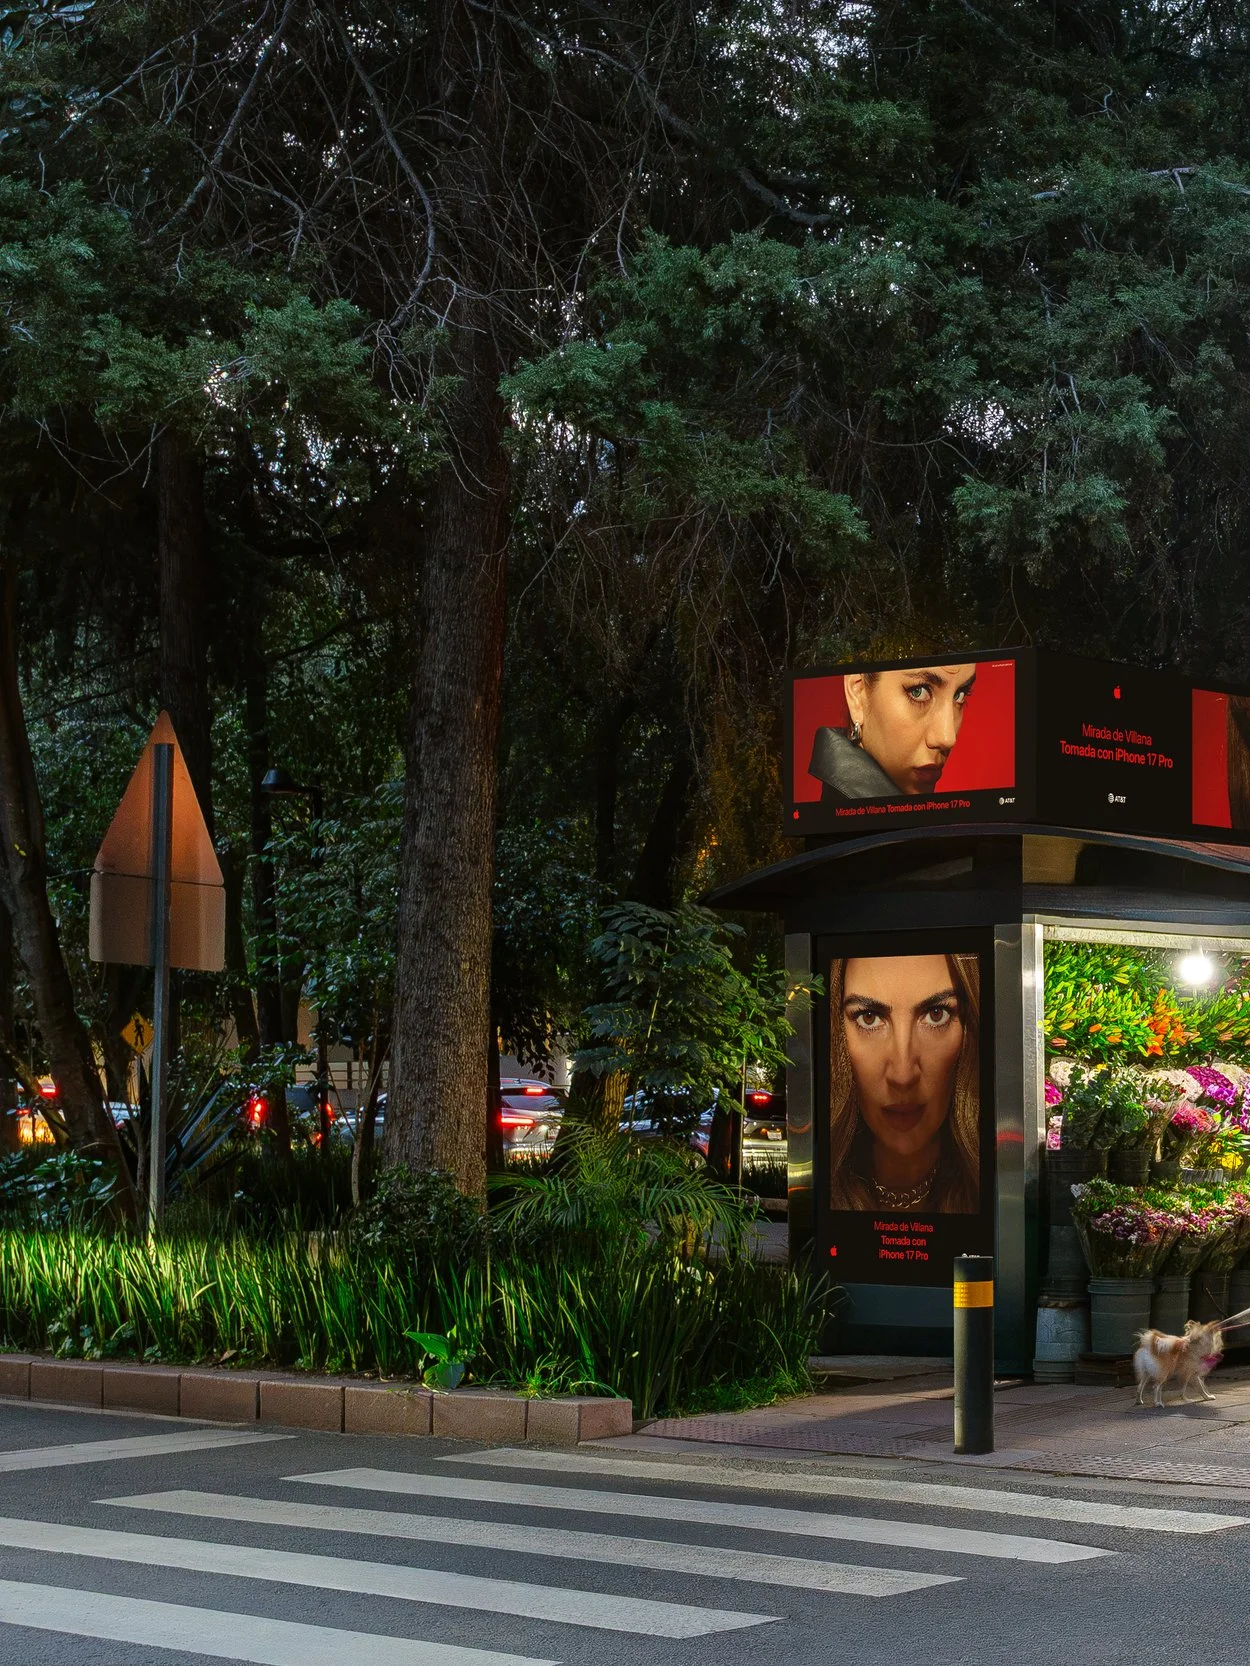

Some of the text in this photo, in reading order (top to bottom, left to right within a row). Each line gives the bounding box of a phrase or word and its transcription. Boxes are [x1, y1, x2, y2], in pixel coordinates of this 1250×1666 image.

[1082, 723, 1152, 746] Mirada de Villana
[1060, 740, 1173, 769] Tomada con iPhone 17 Pro
[835, 799, 971, 817] Mirada de Villana Tomada con iPhone 17 Pro
[873, 1220, 934, 1233] Mirada de Villana
[880, 1235, 927, 1246] Tomada con
[879, 1249, 929, 1261] iPhone 17 Pro
